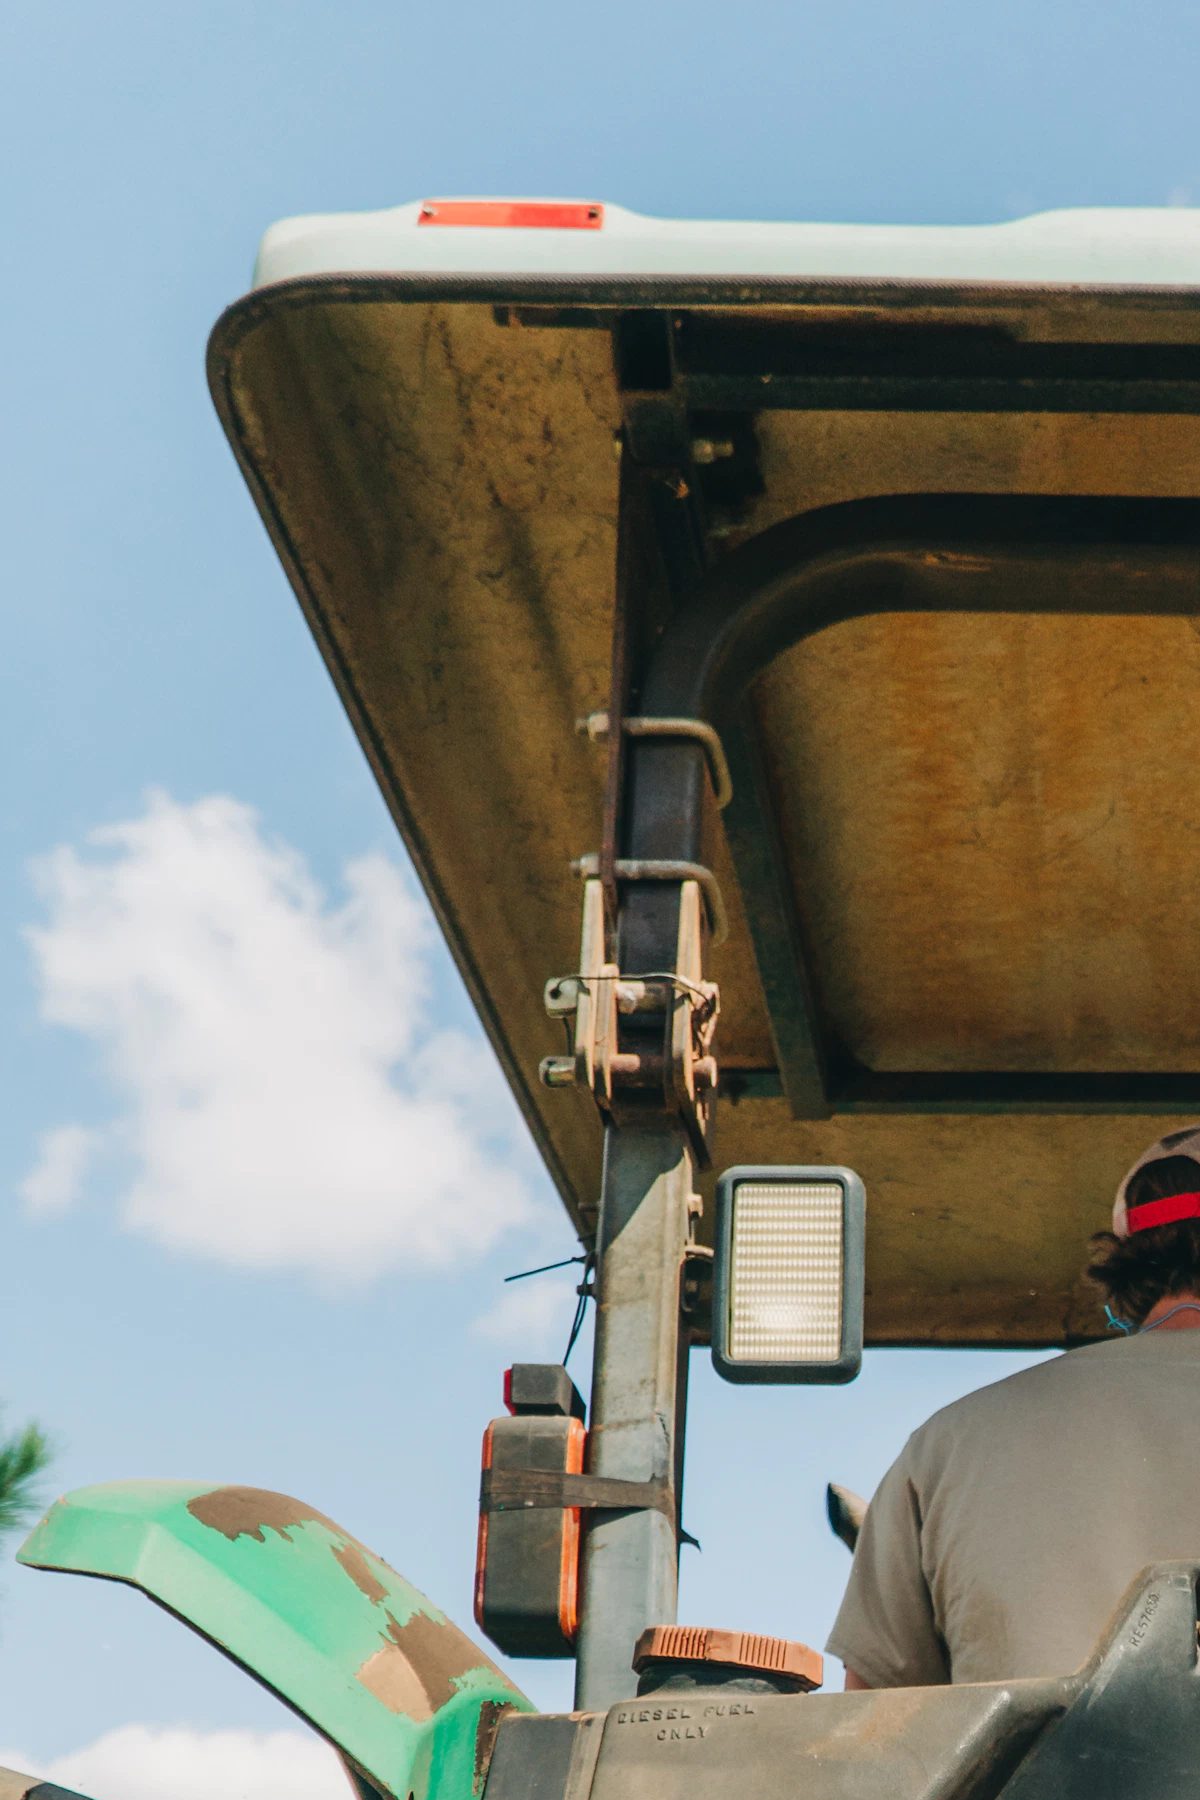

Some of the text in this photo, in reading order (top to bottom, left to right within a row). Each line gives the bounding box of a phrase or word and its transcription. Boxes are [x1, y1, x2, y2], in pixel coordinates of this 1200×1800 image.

[617, 1703, 755, 1724] DIESEL FUEL
[657, 1726, 708, 1741] ONLY
